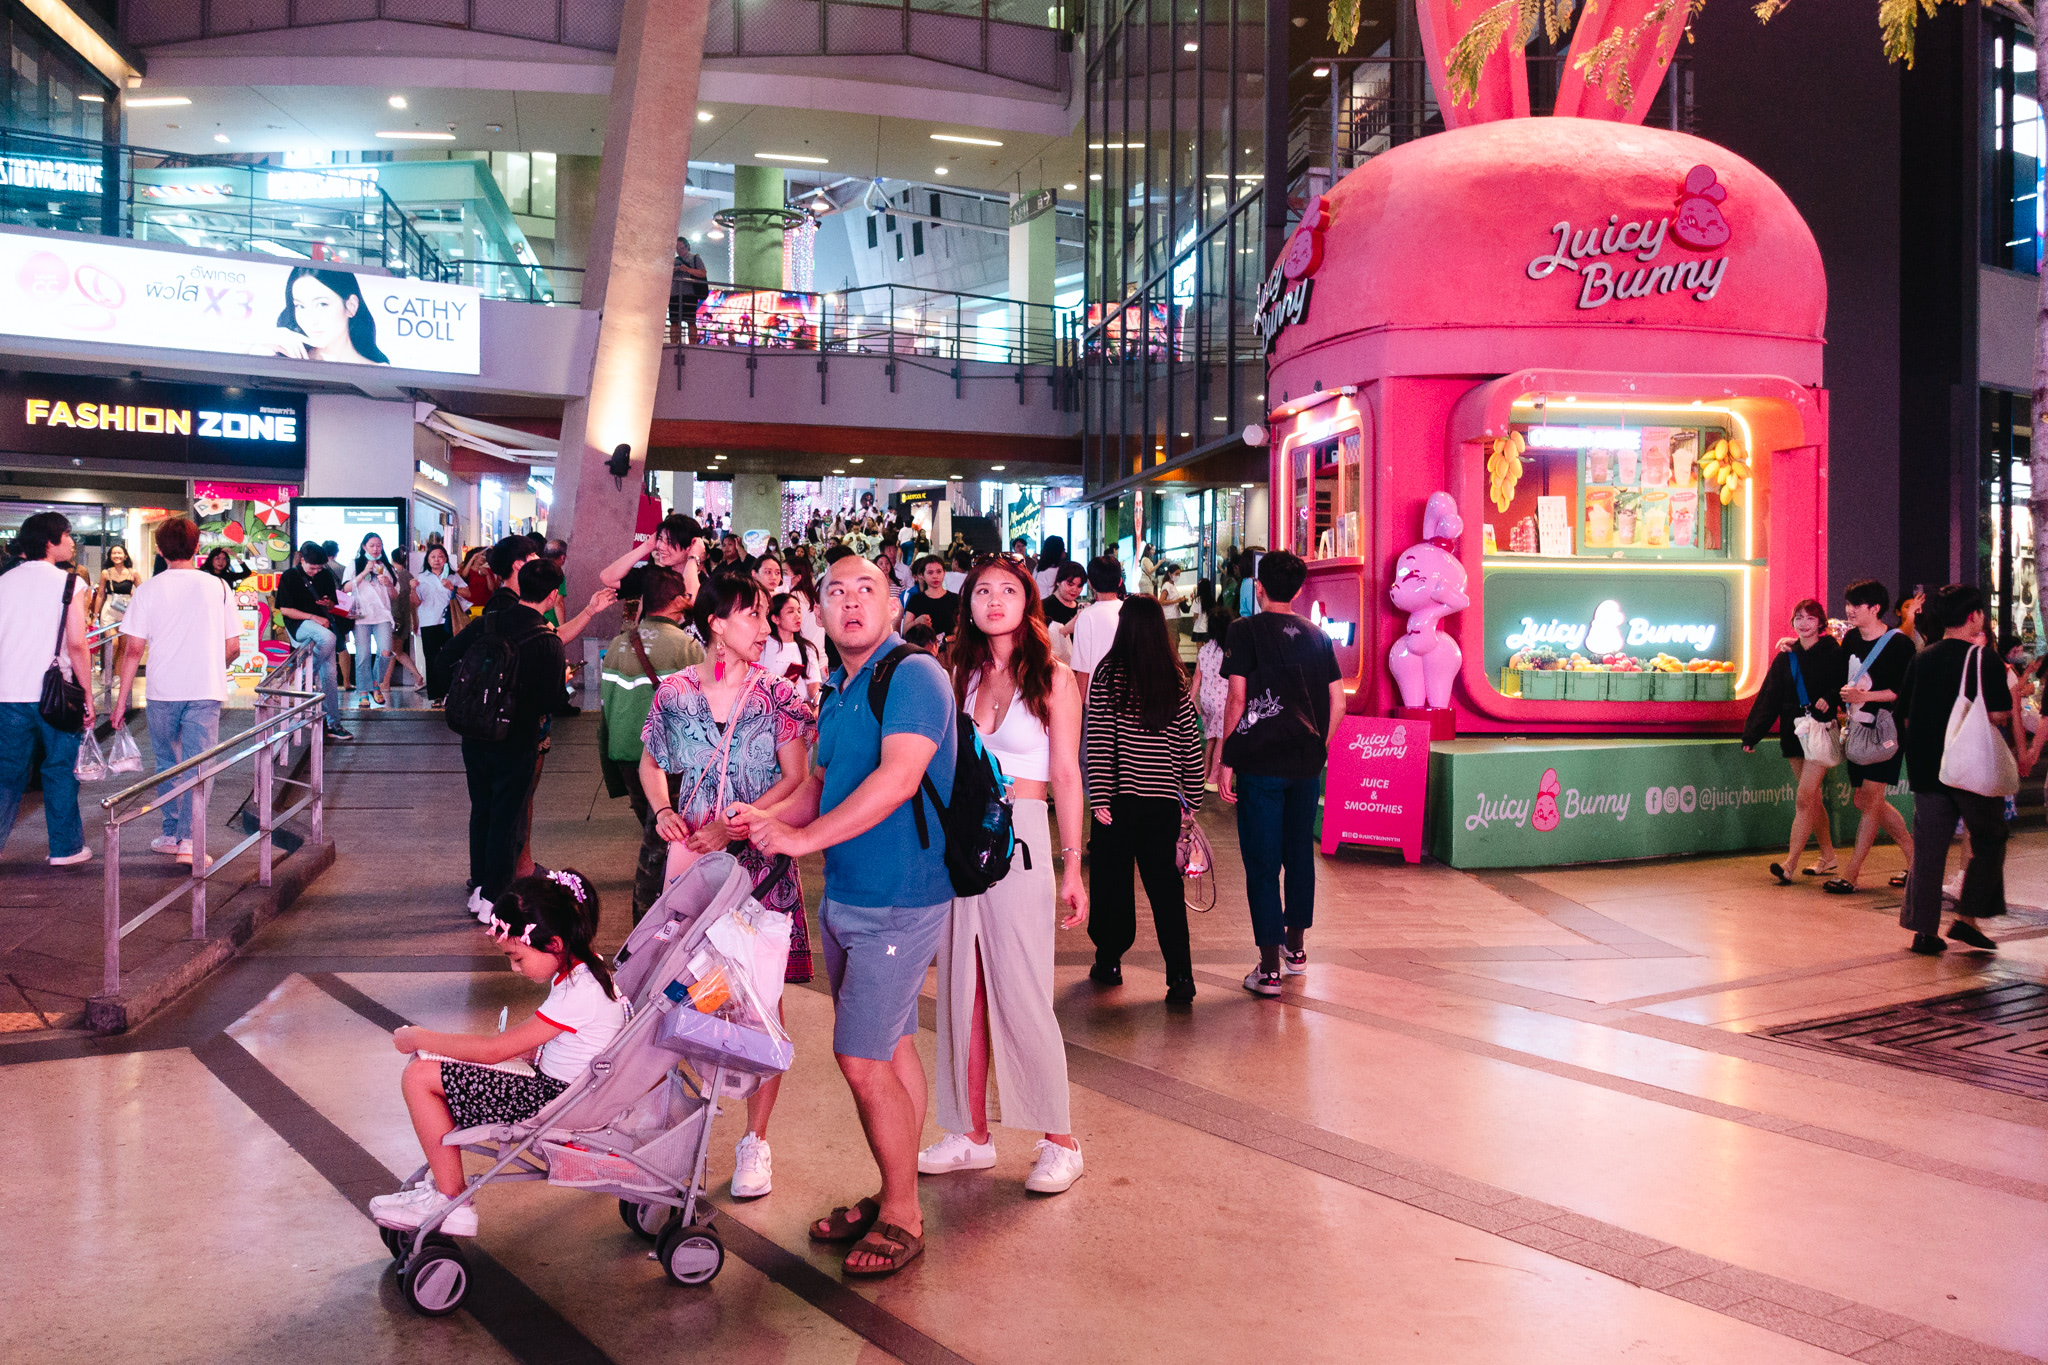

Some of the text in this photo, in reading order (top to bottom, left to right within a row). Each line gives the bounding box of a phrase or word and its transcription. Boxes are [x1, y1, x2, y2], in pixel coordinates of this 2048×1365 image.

[1528, 214, 1668, 279] Juicy
[190, 265, 246, 284] อัพเกรด
[1578, 257, 1728, 308] Bunny
[383, 295, 467, 321] CATHY
[398, 317, 454, 341] DOLL
[26, 398, 297, 443] FASHION ZONE
[1505, 617, 1716, 651] Juicy Bunny
[1348, 734, 1390, 750] Juicy
[1361, 745, 1407, 759] Bunny
[1360, 778, 1390, 789] JUICE
[1370, 791, 1378, 800] &
[1344, 800, 1403, 815] SMOOTHIES
[1465, 793, 1529, 831] Juicy
[1564, 788, 1631, 821] Bunny
[1699, 782, 1794, 811] @juicybunnyth
